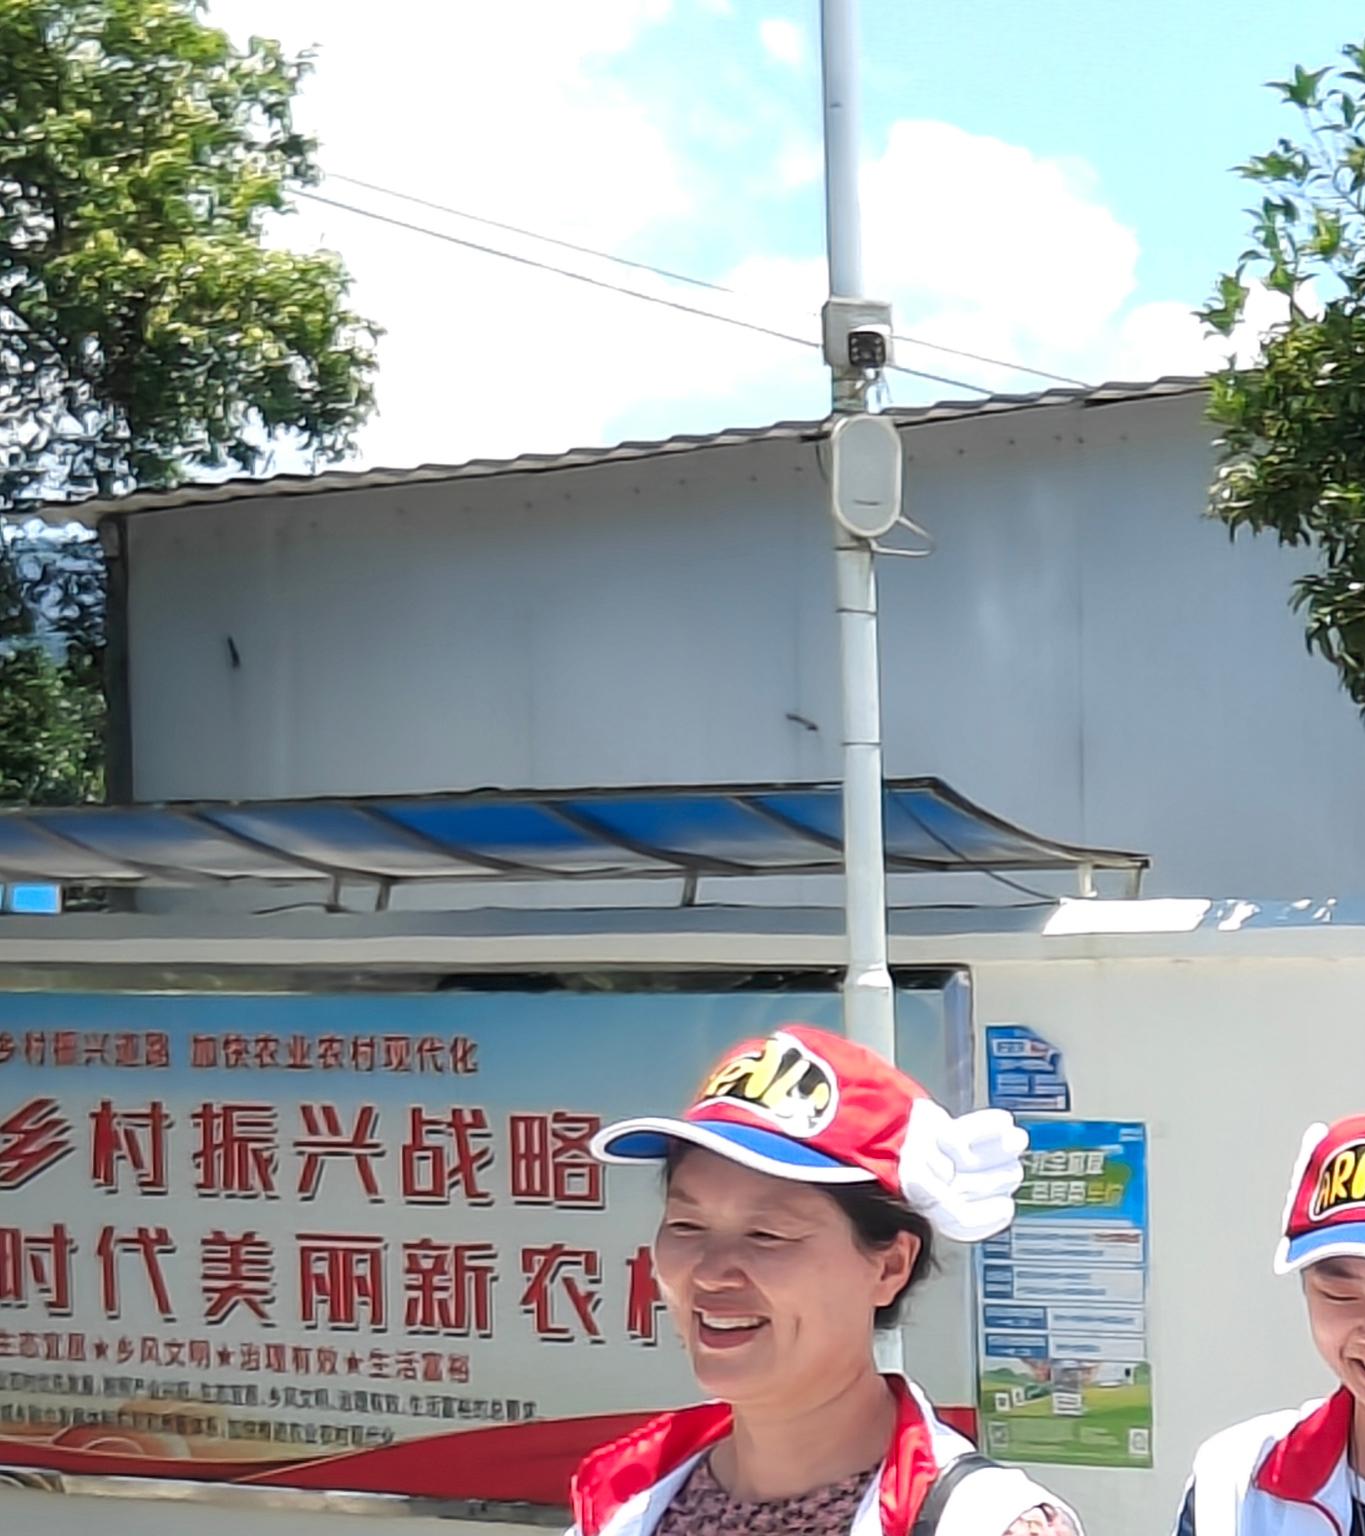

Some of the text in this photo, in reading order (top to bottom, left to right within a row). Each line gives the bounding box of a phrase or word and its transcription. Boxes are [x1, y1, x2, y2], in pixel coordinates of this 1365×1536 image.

[0, 1098, 606, 1208] 乡村振兴战略
